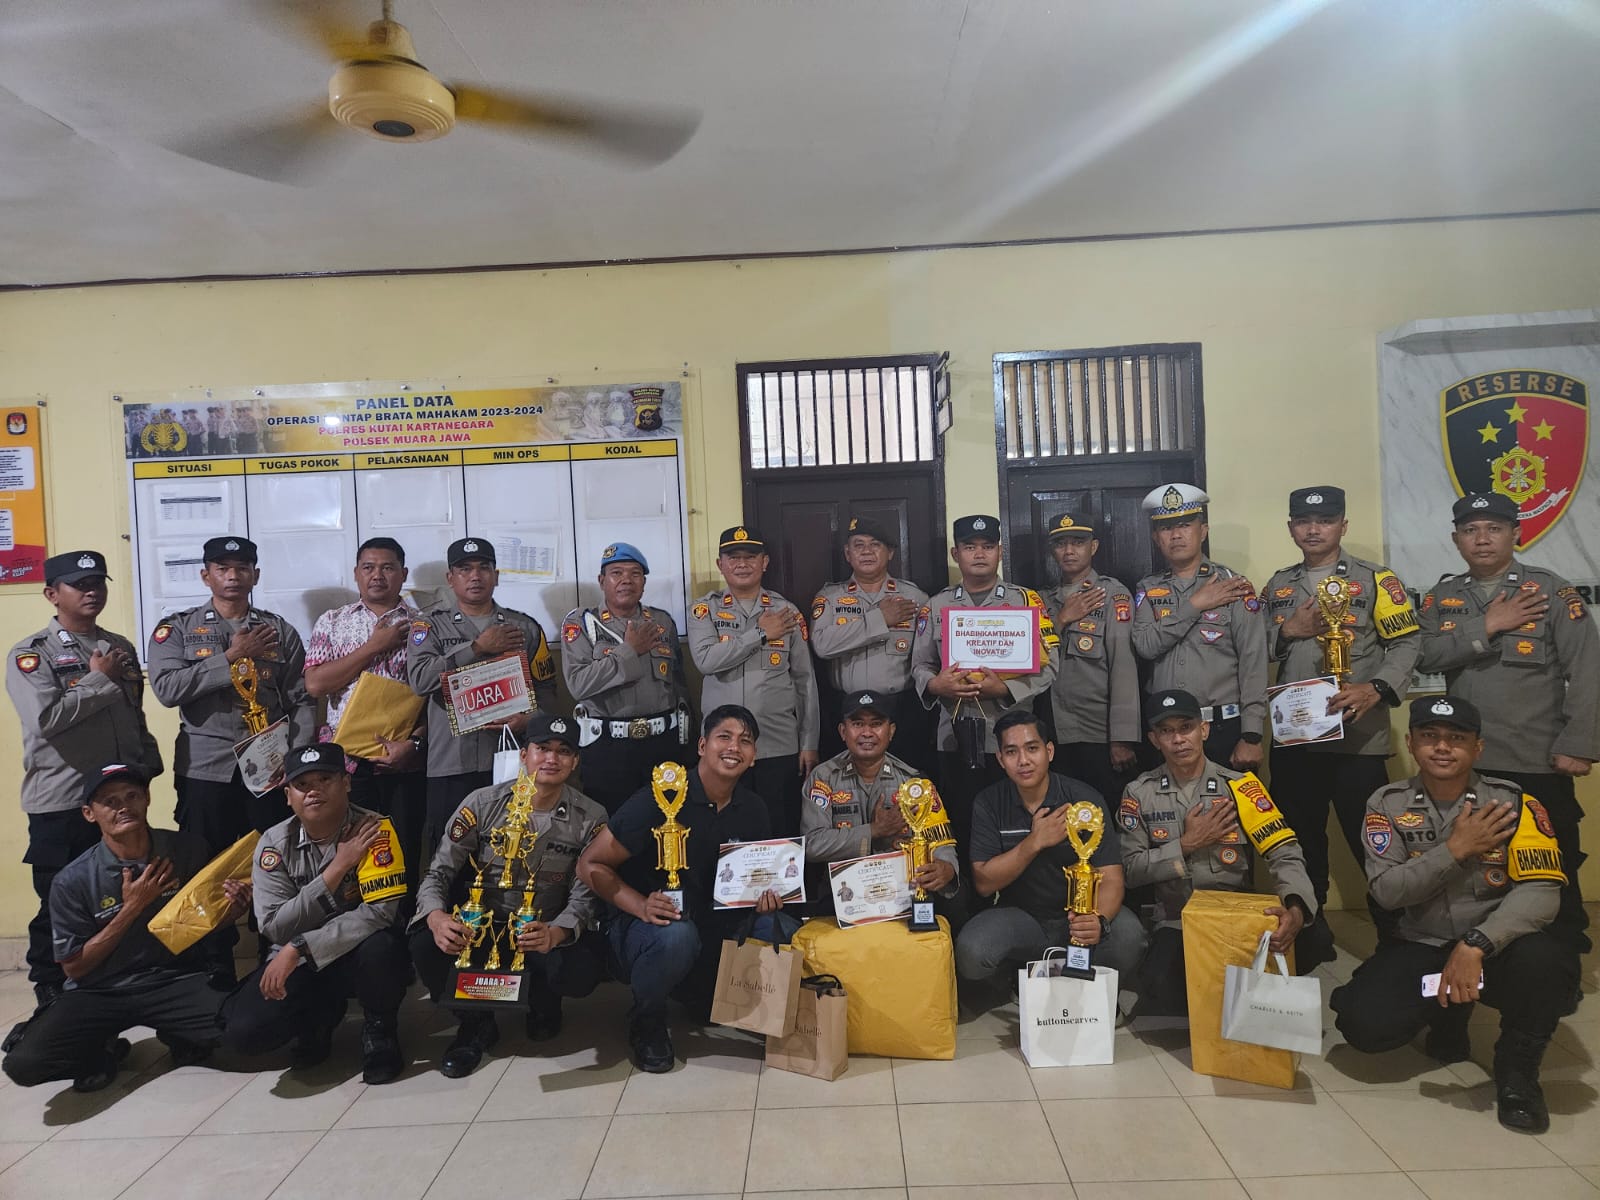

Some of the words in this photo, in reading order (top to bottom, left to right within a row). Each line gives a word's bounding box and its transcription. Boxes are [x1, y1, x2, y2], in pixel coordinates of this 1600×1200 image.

[1457, 373, 1575, 402] RESERSE
[356, 398, 410, 410] PANEL
[413, 395, 454, 407] DATA
[267, 415, 320, 426] OPERASI
[323, 412, 372, 425] NTAP
[375, 411, 413, 421] BRATA
[416, 408, 478, 420] MAHAKAM
[480, 406, 544, 417] 2023-2024
[319, 425, 366, 436] POLRES
[369, 422, 403, 433] KUTAI
[406, 420, 494, 431] KARTANEGARA
[343, 436, 390, 446] POLSEK
[393, 434, 436, 445] MUARA
[439, 433, 471, 443] JAWA
[493, 451, 515, 460] MIN
[517, 449, 540, 459] OPS
[605, 445, 642, 455] KODAL
[259, 460, 297, 471] TUGAS
[300, 458, 340, 469] POKOK
[367, 454, 449, 465] PELAKSANAAN
[167, 464, 212, 473] SITUASI
[835, 606, 862, 614] WIYONO
[955, 630, 1026, 638] BHABINKAMTIBMAS
[458, 683, 505, 715] JUARA
[474, 976, 498, 986] JUARA
[1036, 1017, 1099, 1027] buttonscarves
